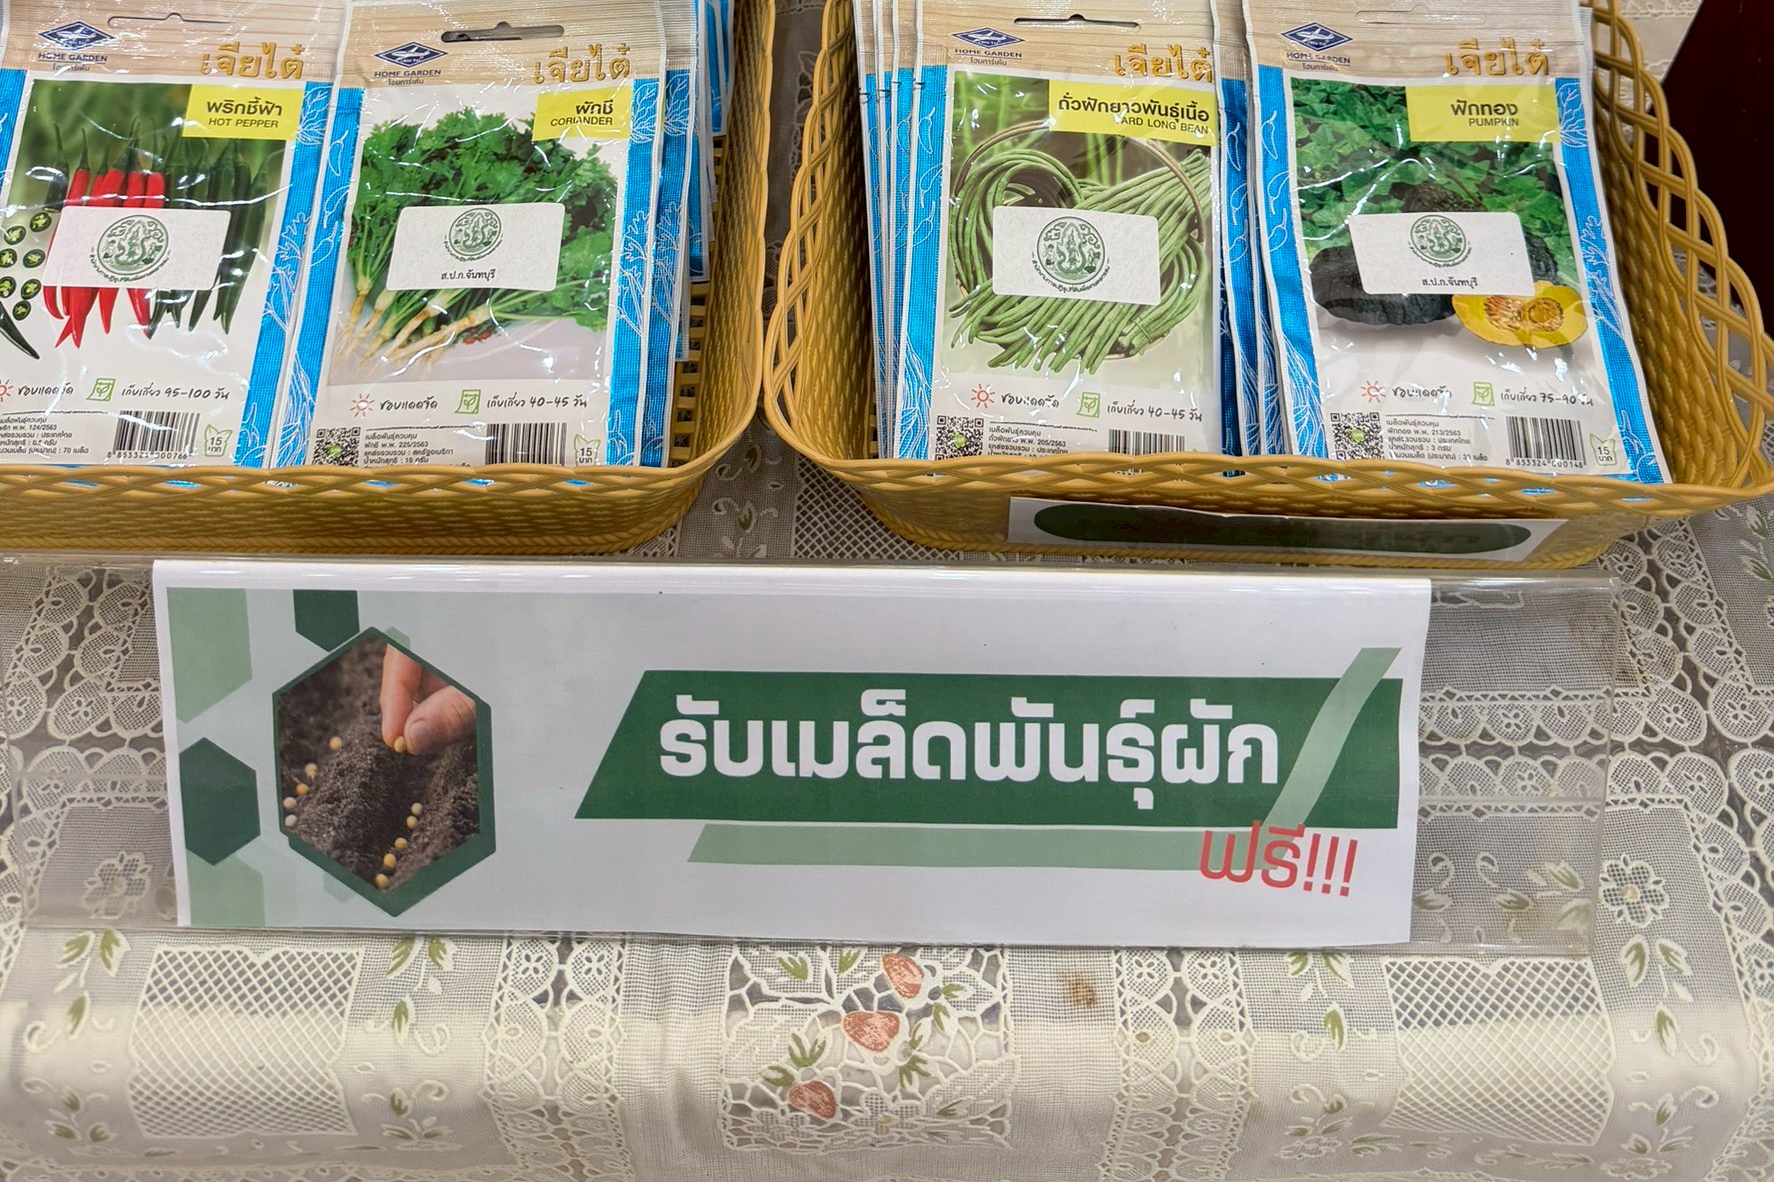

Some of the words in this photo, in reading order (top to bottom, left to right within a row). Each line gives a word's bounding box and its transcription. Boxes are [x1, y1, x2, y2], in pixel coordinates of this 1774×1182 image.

[984, 49, 1023, 58] GARDEN
[1286, 52, 1313, 60] HOME
[1315, 54, 1351, 64] GARDEN
[1445, 37, 1550, 76] เจียไต๋
[533, 42, 632, 85] เจียไต๋
[1114, 43, 1213, 85] เจียไต๋
[374, 69, 402, 78] HOME
[403, 68, 442, 77] GARDEN
[206, 95, 283, 118] พริกชี้ฟ้า
[575, 98, 614, 117] ผักชี
[1450, 99, 1519, 116] ฟักทอง
[208, 117, 231, 128] HOT
[235, 118, 279, 129] PEPPER
[550, 115, 614, 127] CORIANDER
[1114, 115, 1144, 127] ARD
[1147, 117, 1177, 130] LONG
[1180, 122, 1210, 135] BEAN
[1468, 117, 1519, 127] PUMPKIN
[440, 268, 497, 282] ส.ป.ก.จันทบุรี
[1421, 276, 1478, 290] ส.ป.ก.จันทบุรี
[164, 388, 211, 399] 95-100
[215, 387, 231, 400] วัน
[1540, 391, 1577, 406] 75-90
[529, 395, 570, 408] 40-45
[572, 394, 588, 409] วัน
[1147, 406, 1186, 420] 40-45
[1188, 407, 1203, 422] วัน
[209, 436, 223, 446] 15
[580, 447, 593, 456] 15
[1597, 446, 1611, 455] 15
[1516, 458, 1547, 467] 853324
[659, 688, 1280, 810] รับเมล็ดพันธุ์ผัก
[1197, 819, 1358, 898] ฟรี!!!
